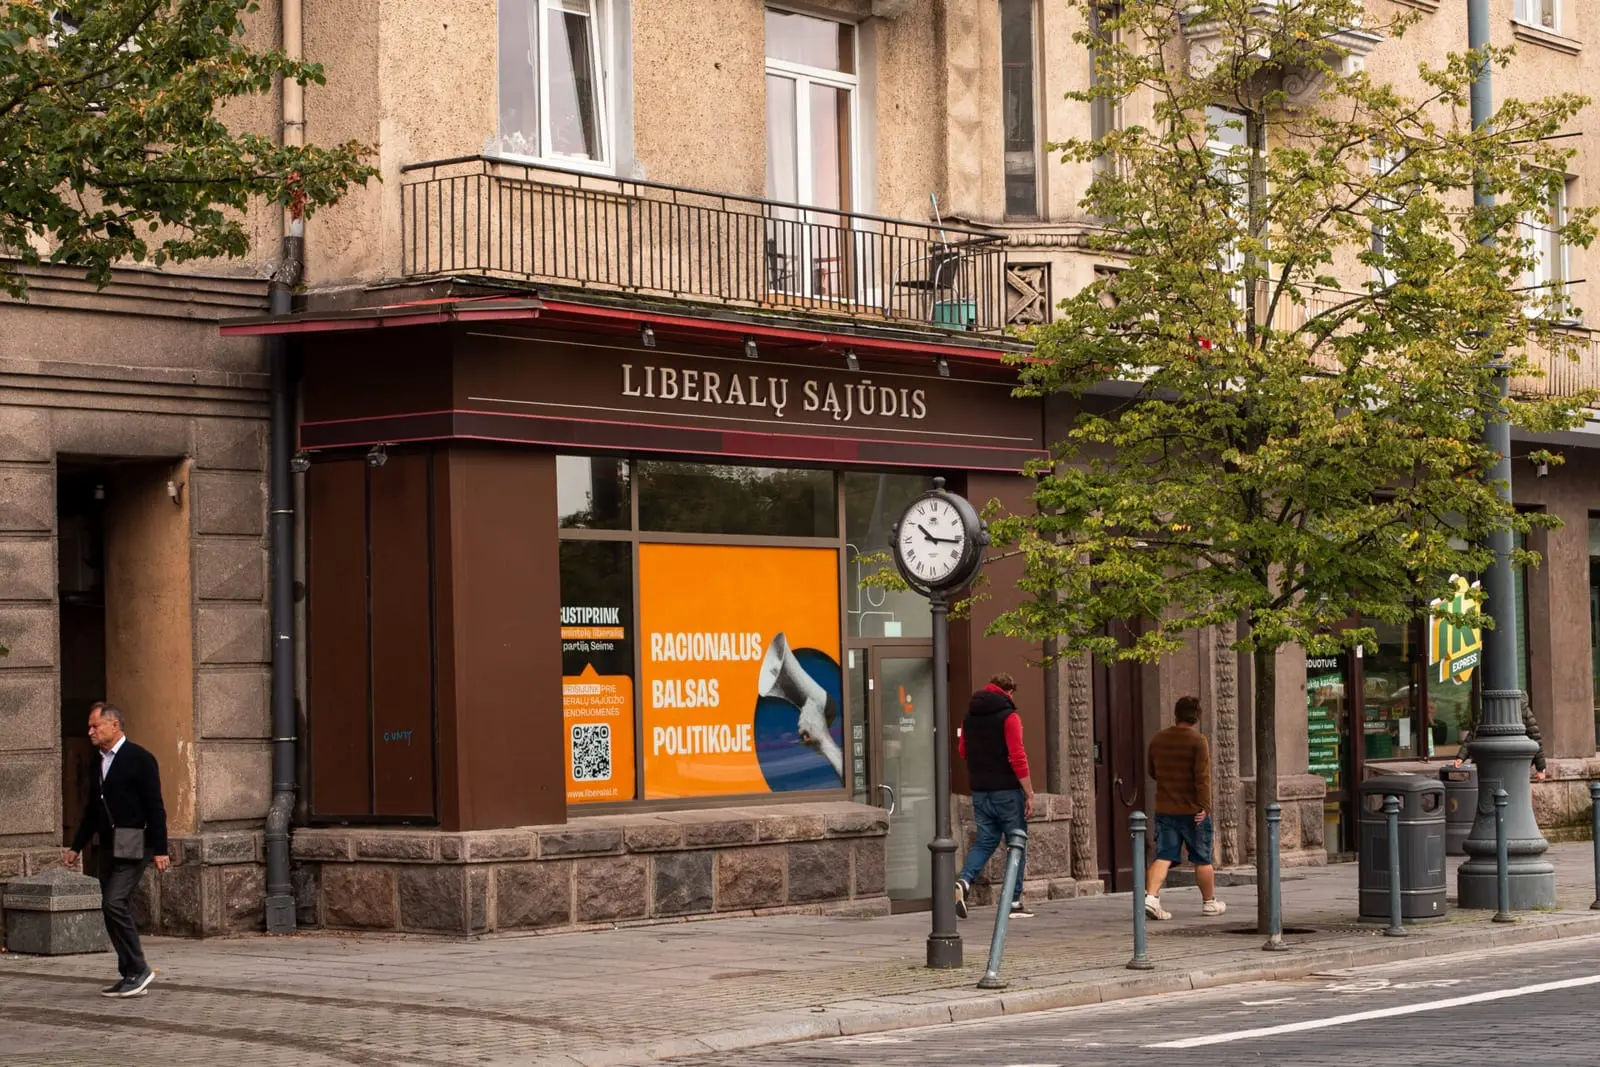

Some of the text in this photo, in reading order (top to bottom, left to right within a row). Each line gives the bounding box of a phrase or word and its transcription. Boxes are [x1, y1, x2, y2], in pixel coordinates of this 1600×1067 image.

[621, 363, 927, 422] LIBERALŲ SĄJŪDIS
[563, 641, 614, 652] partiją Seime
[651, 632, 762, 662] RACIONALUS
[1452, 653, 1478, 673] EXPRESS
[601, 684, 617, 694] PRIE
[652, 678, 720, 709] BALSAS
[653, 724, 752, 756] POLITIKOJE
